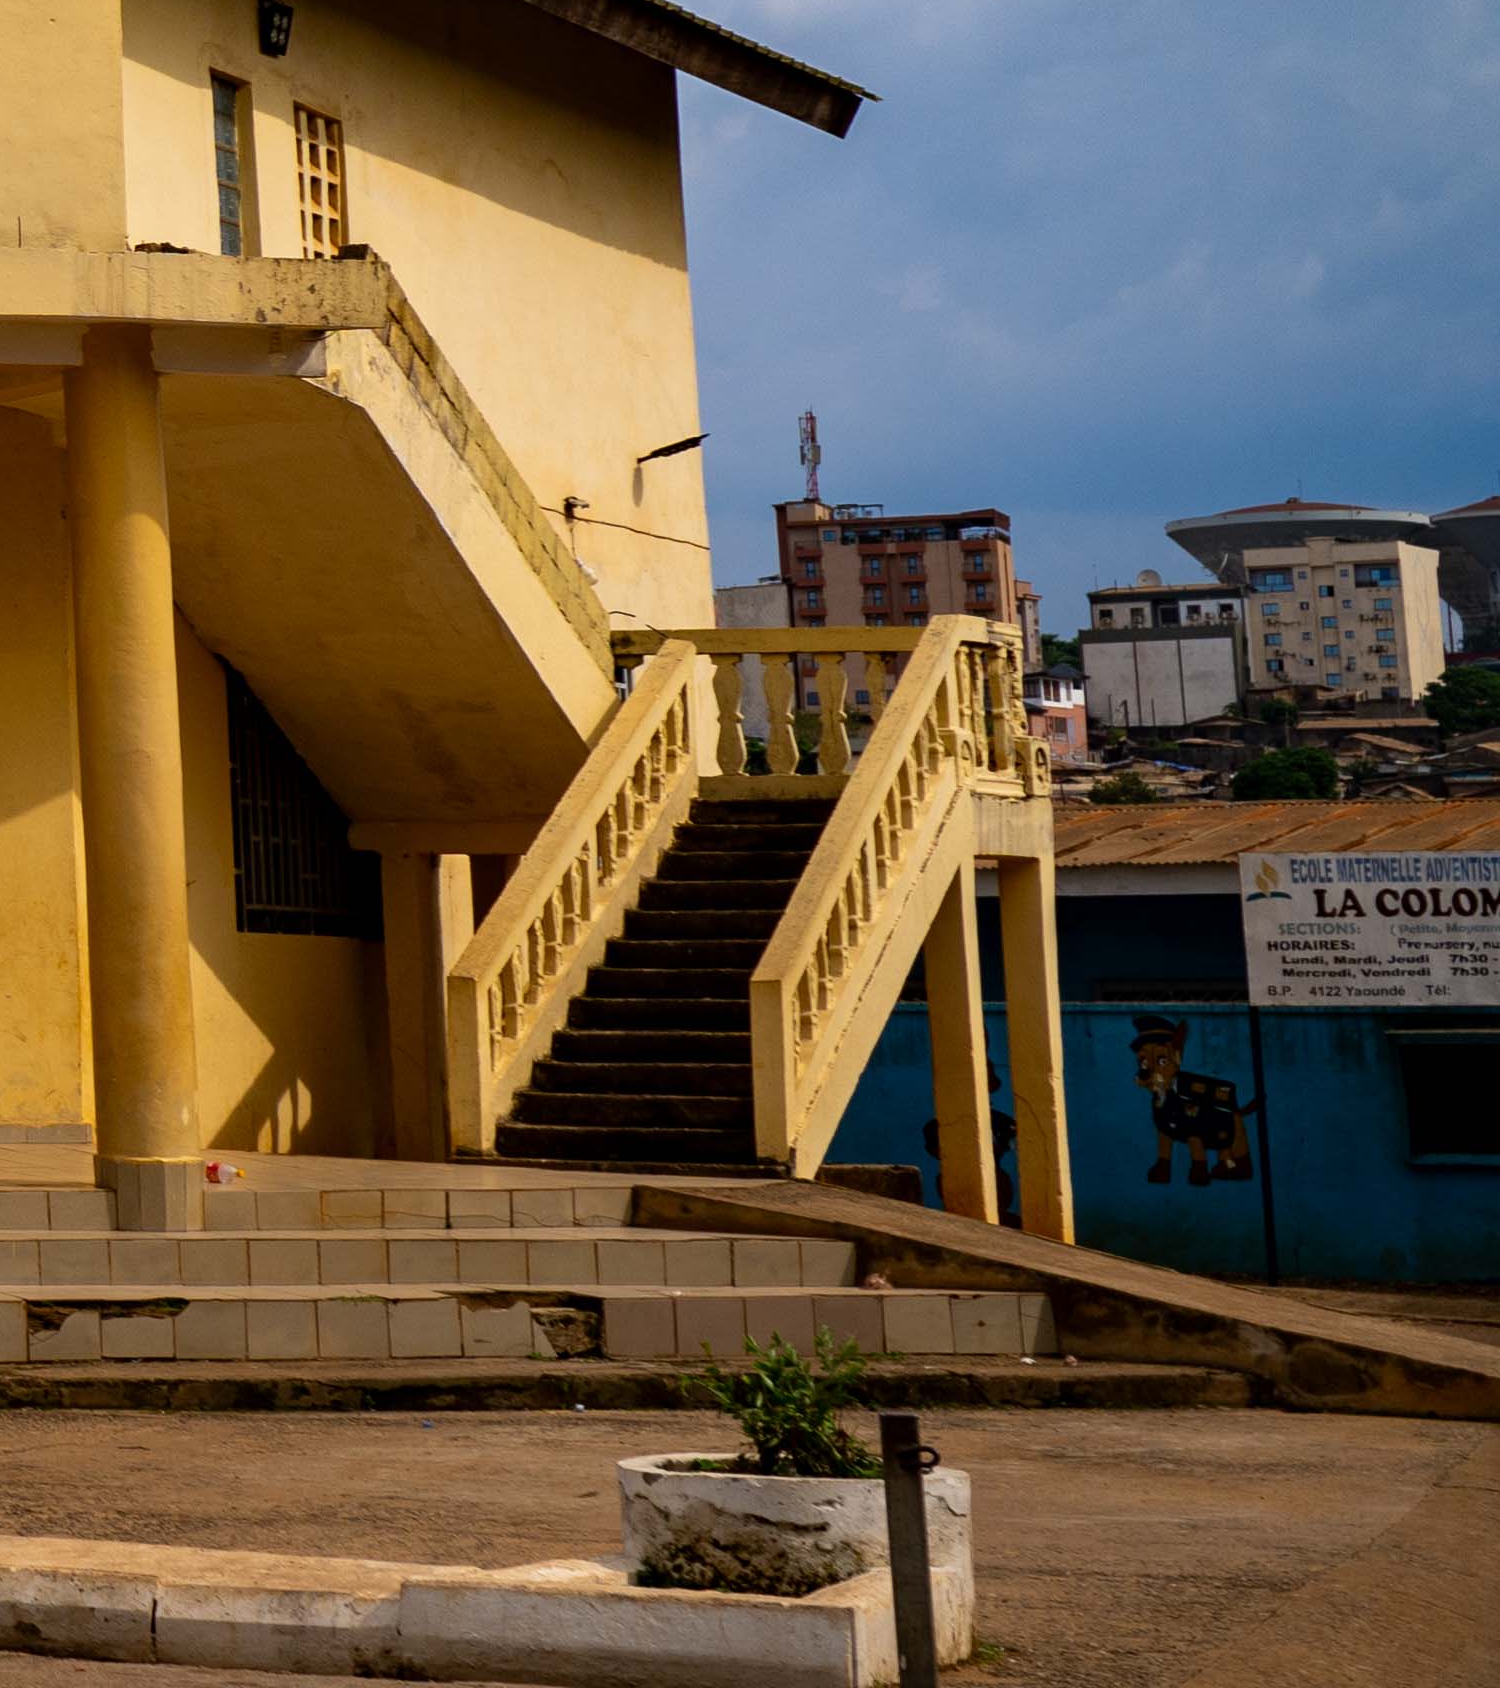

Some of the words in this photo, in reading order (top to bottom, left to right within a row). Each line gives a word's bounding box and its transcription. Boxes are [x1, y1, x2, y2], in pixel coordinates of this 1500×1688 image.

[1290, 859, 1334, 884] ECOLE
[1336, 857, 1422, 883] MATERNELLE
[1313, 888, 1366, 918] LA
[1278, 923, 1361, 936] SECTIONS:
[1267, 940, 1355, 951] HORAIRES:
[1282, 955, 1329, 966] Lundi,
[1334, 955, 1382, 966] Mardi,
[1388, 954, 1429, 964] Jeudi
[1450, 954, 1488, 963] 7h30
[1282, 968, 1356, 979] Mercredi,
[1361, 967, 1431, 976] Vendredi
[1450, 967, 1489, 976] 7h30
[1267, 985, 1293, 996] B.P.
[1309, 986, 1341, 997] 4122
[1346, 985, 1405, 997] Yaoundé
